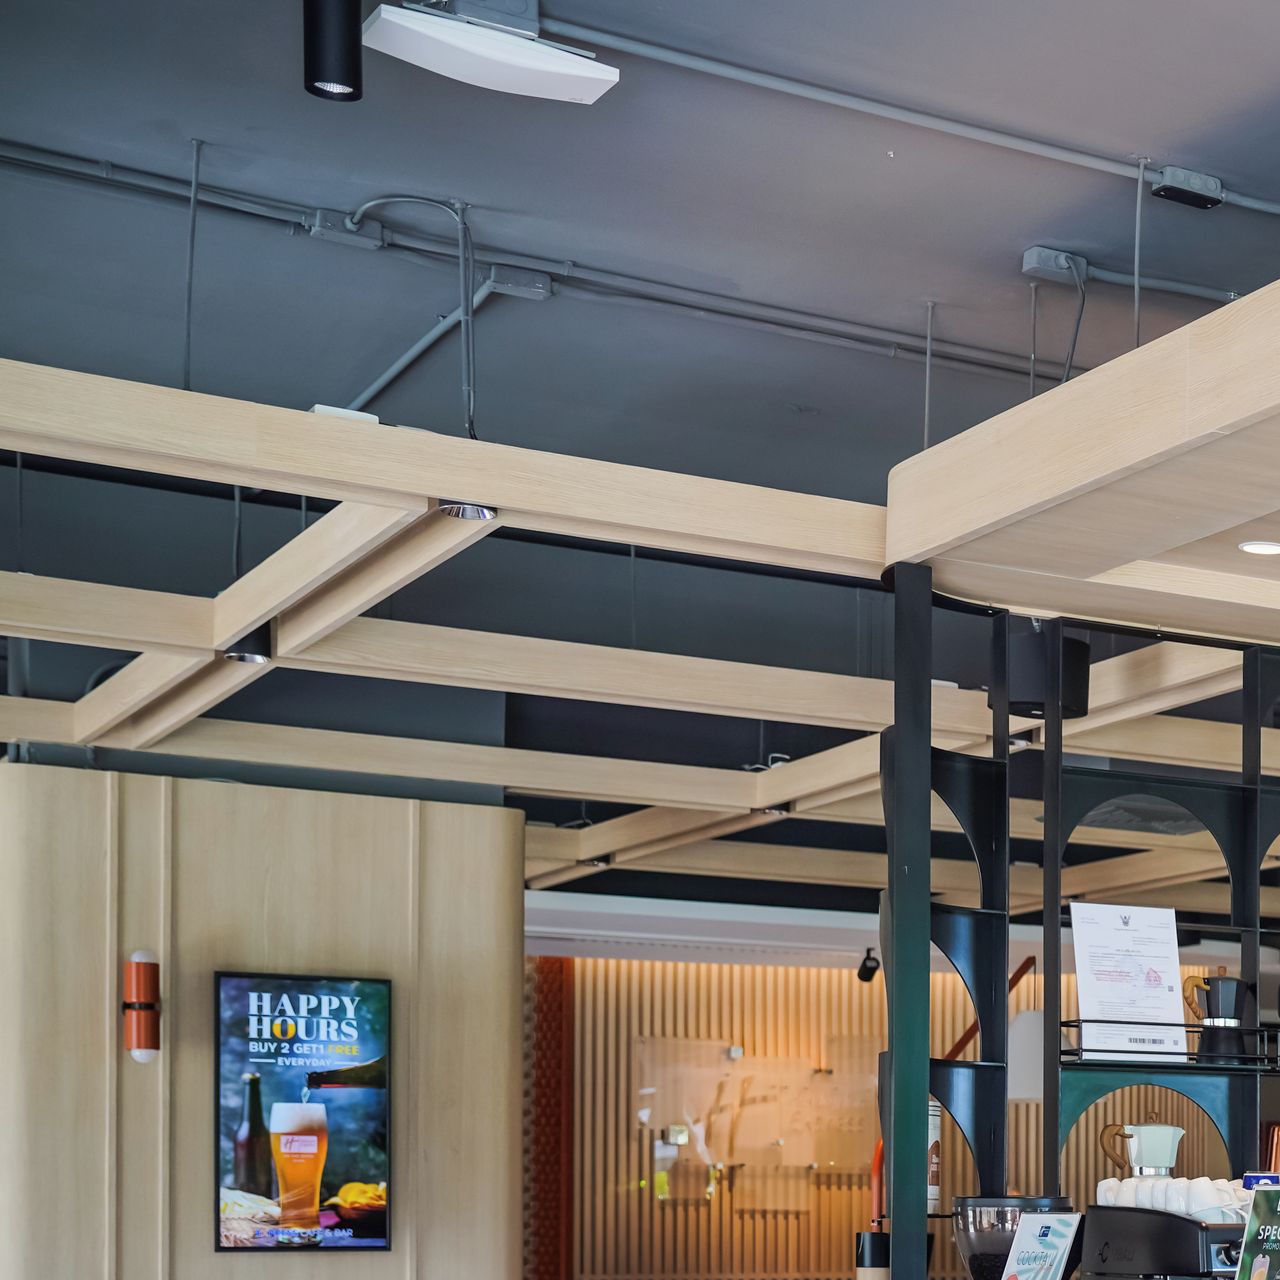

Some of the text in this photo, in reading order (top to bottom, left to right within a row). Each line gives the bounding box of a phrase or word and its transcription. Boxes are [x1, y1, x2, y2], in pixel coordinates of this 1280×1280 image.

[248, 992, 361, 1019] HAPPY
[248, 1015, 358, 1042] HOURS
[249, 1041, 277, 1053] BUY
[281, 1043, 290, 1054] 2
[328, 1044, 359, 1055] FREE
[277, 1056, 331, 1067] EVERYDAY
